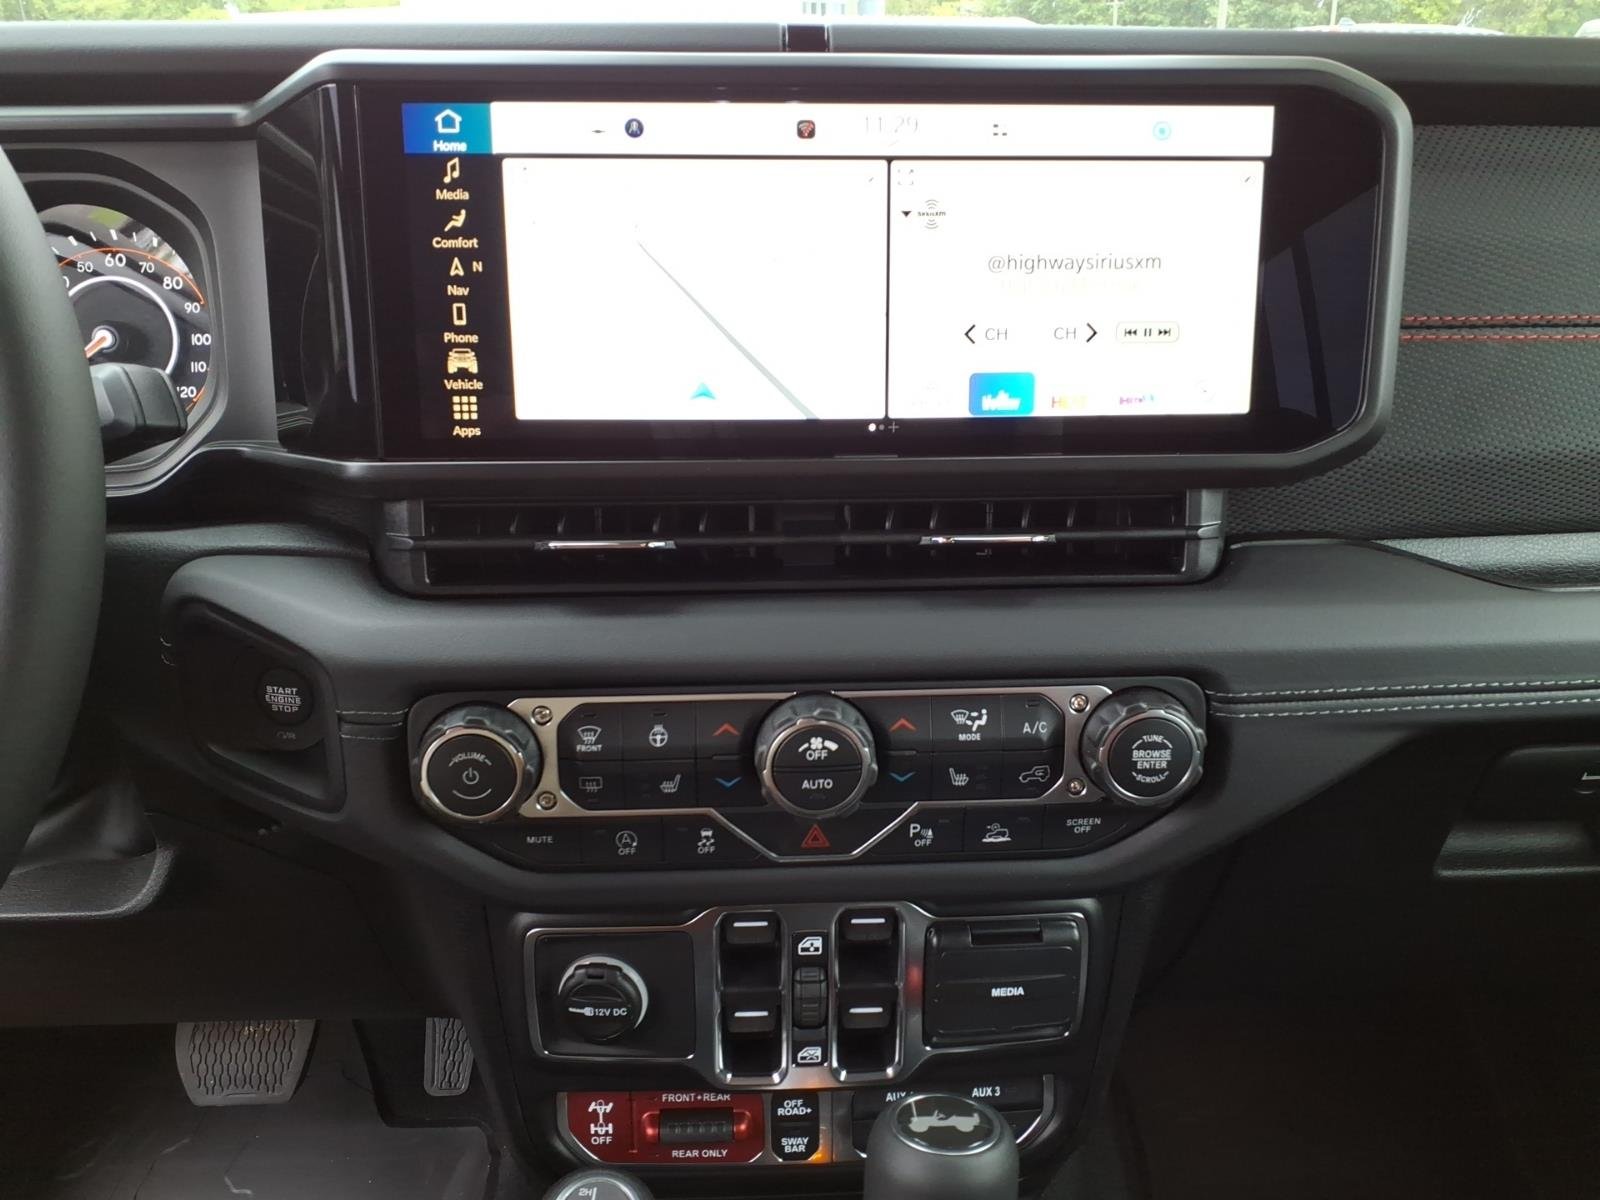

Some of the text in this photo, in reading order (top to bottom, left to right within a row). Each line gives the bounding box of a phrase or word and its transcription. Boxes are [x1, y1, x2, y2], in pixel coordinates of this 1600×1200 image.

[864, 115, 919, 135] 1129
[432, 140, 467, 153] Home
[435, 188, 470, 201] Media
[432, 236, 478, 249] Comfort
[105, 253, 126, 268] 60
[987, 253, 1162, 275] @highwaysiriusxm
[77, 261, 94, 273] 50
[139, 261, 155, 273] 70
[472, 261, 483, 273] N
[162, 276, 183, 290] 80
[447, 284, 470, 297] Nav
[184, 302, 200, 314] 90
[443, 332, 479, 344] Phone
[984, 327, 1008, 341] CH
[1053, 326, 1077, 340] CH
[191, 333, 212, 346] 100
[190, 362, 207, 373] 110
[444, 379, 483, 391] Vehicle
[453, 425, 481, 438] Apps
[265, 685, 298, 695] START
[265, 694, 301, 704] ENGINE
[271, 704, 299, 712] STOP
[1023, 721, 1048, 735] A/C
[958, 733, 981, 741] MODE
[1142, 734, 1164, 743] TUNE
[576, 744, 602, 753] FRONT
[1132, 749, 1171, 758] BROWSE
[453, 751, 486, 762] VOLUME
[806, 749, 828, 760] OFF
[1137, 760, 1168, 769] ENTER
[1135, 774, 1166, 783] SCROLL
[802, 778, 833, 791] AUTO
[1066, 817, 1102, 826] SCREEN
[1074, 825, 1092, 834] OFF
[526, 836, 553, 844] MUTE
[914, 837, 932, 846] OFF
[618, 847, 637, 856] OFF
[697, 846, 716, 854] OFF
[991, 987, 1024, 997] MEDIA
[594, 1008, 628, 1016] 12V DC
[971, 1086, 1001, 1098] AUX 3
[783, 1100, 804, 1108] OFF
[591, 1136, 612, 1145] OFF
[780, 1137, 809, 1146] SWAY
[671, 1149, 728, 1158] REAR ONLY
[784, 1144, 806, 1153] BAR
[578, 1188, 593, 1196] 2H
